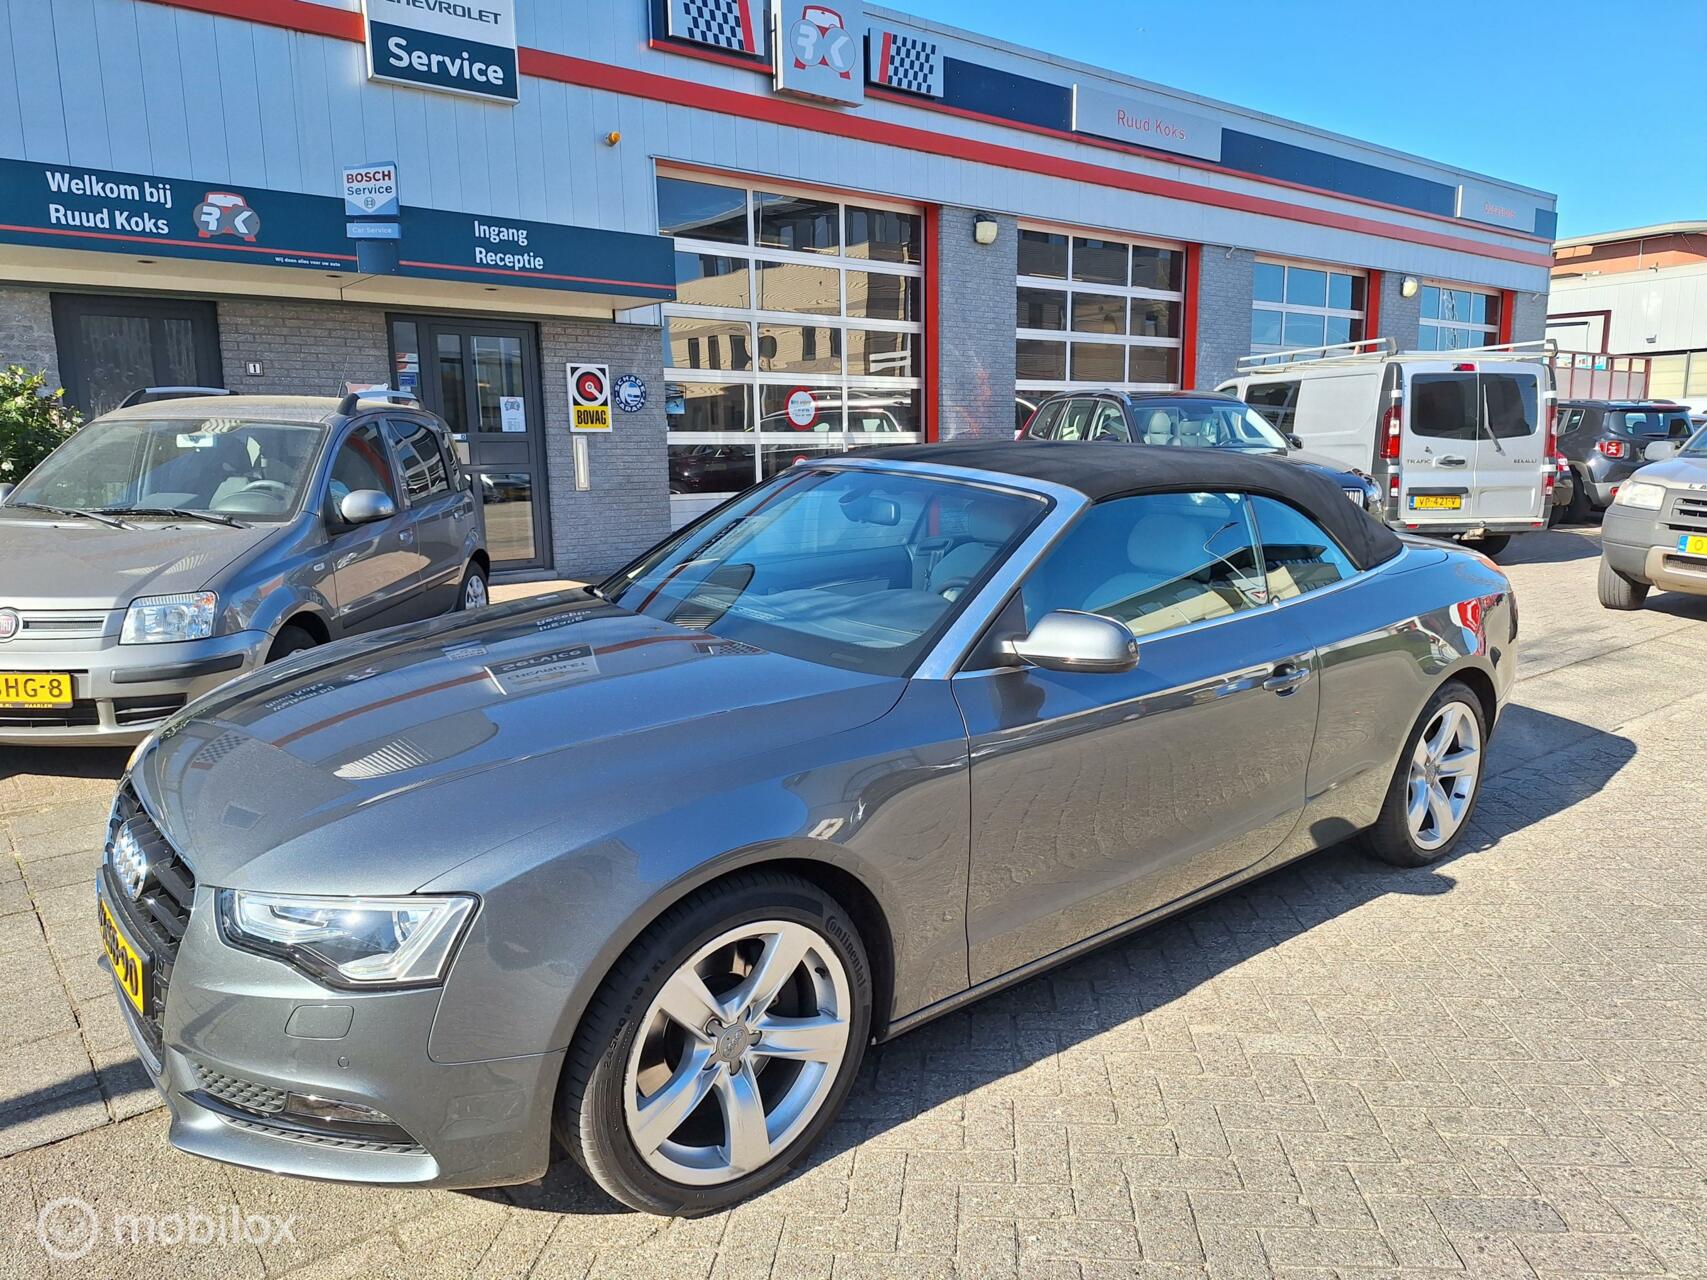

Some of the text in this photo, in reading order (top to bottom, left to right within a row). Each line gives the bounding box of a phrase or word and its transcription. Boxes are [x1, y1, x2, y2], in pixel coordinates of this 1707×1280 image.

[387, 36, 504, 85] Service
[1117, 109, 1186, 140] Ruud Koks
[45, 170, 173, 209] Welkom bij
[346, 170, 392, 184] BOSCH
[347, 184, 393, 196] Service
[49, 203, 170, 235] Ruud Koks
[366, 226, 393, 234] Service
[474, 220, 528, 246] Ingang
[475, 247, 544, 271] Receptie
[577, 410, 607, 425] BOVAG
[0, 678, 63, 698] HG-8
[825, 915, 867, 988] Continental
